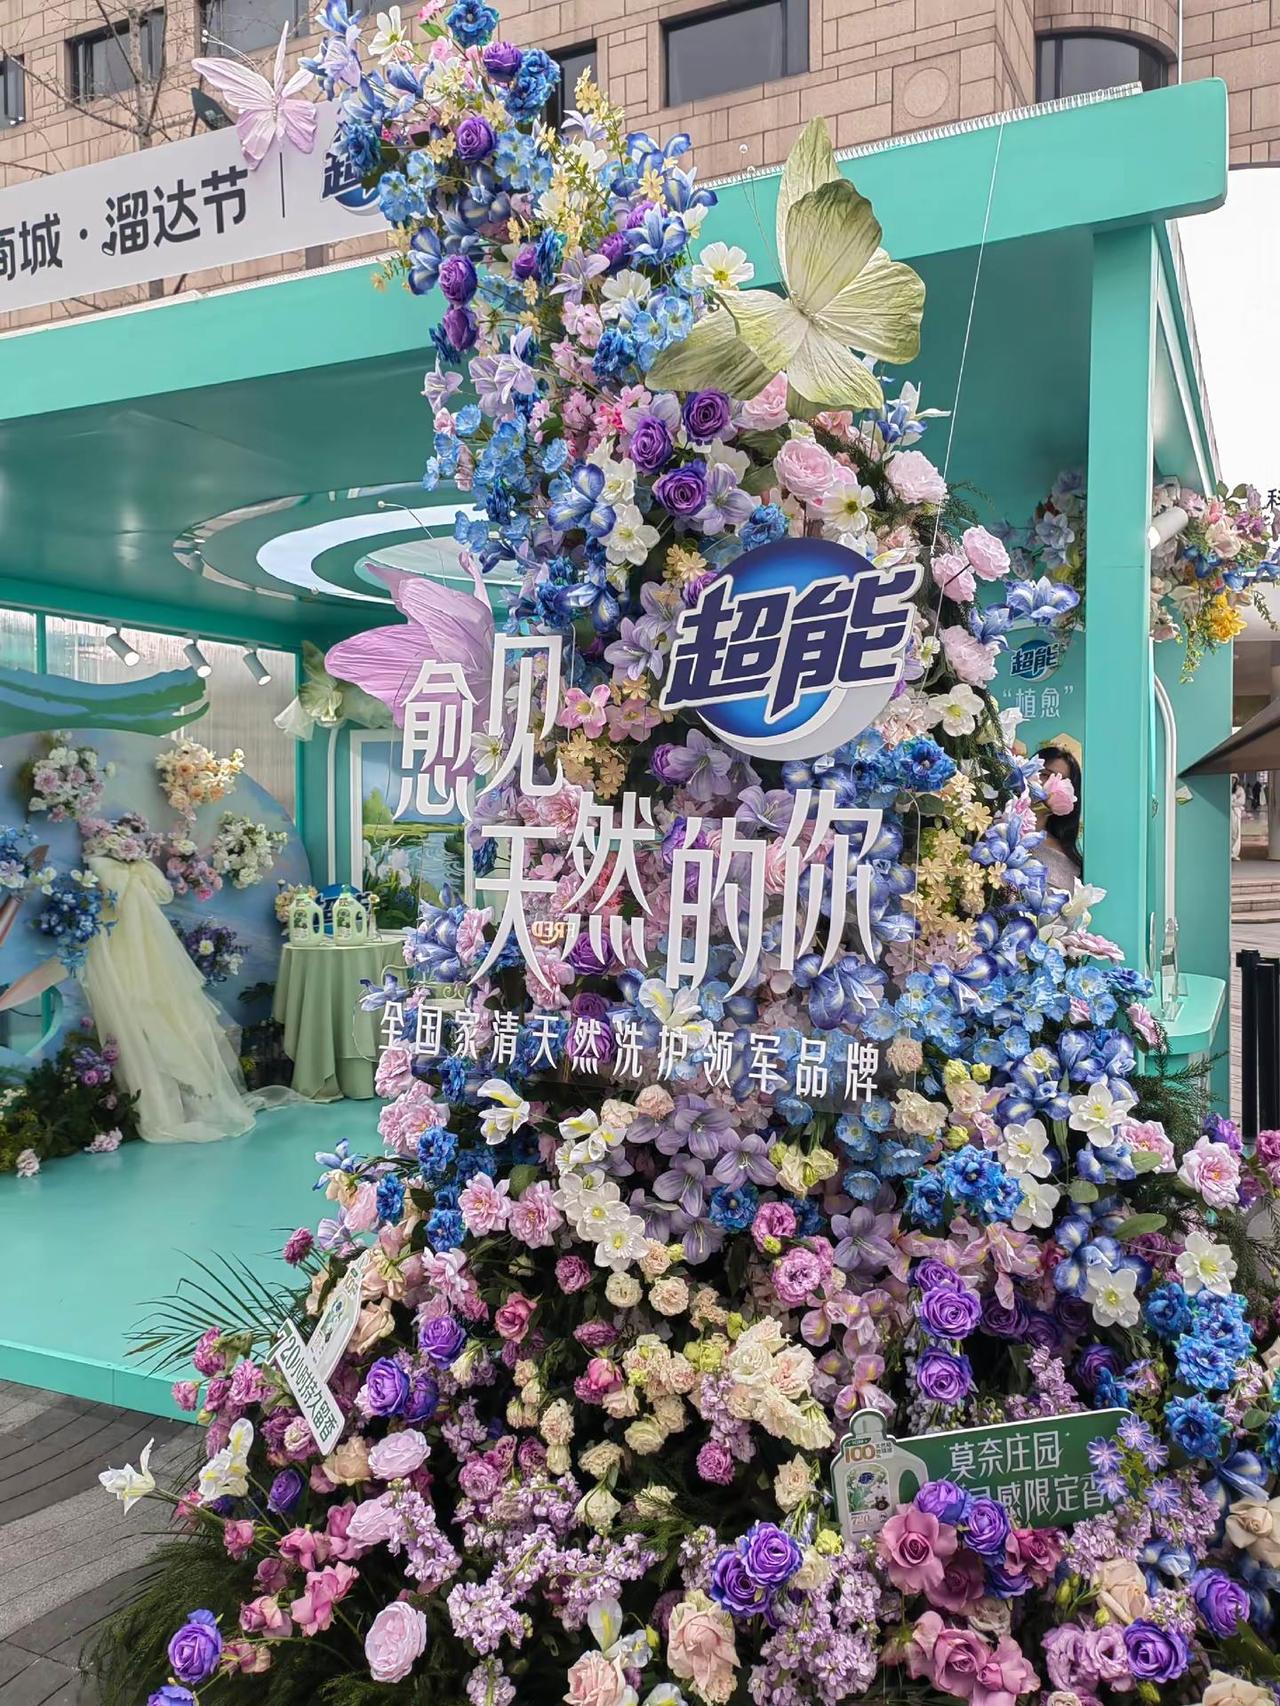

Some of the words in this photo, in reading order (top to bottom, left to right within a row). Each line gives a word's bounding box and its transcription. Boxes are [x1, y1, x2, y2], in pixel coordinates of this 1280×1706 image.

[661, 566, 921, 720] 超能
[1011, 643, 1060, 676] 超能
[393, 633, 563, 822] 愈见
[467, 789, 883, 999] 天然的你
[379, 1000, 880, 1103] 全国家清天然洗护领军品牌
[266, 1320, 339, 1442] 720小时持久留香
[844, 1444, 876, 1463] 100
[947, 1430, 1064, 1480] 莫奈庄园
